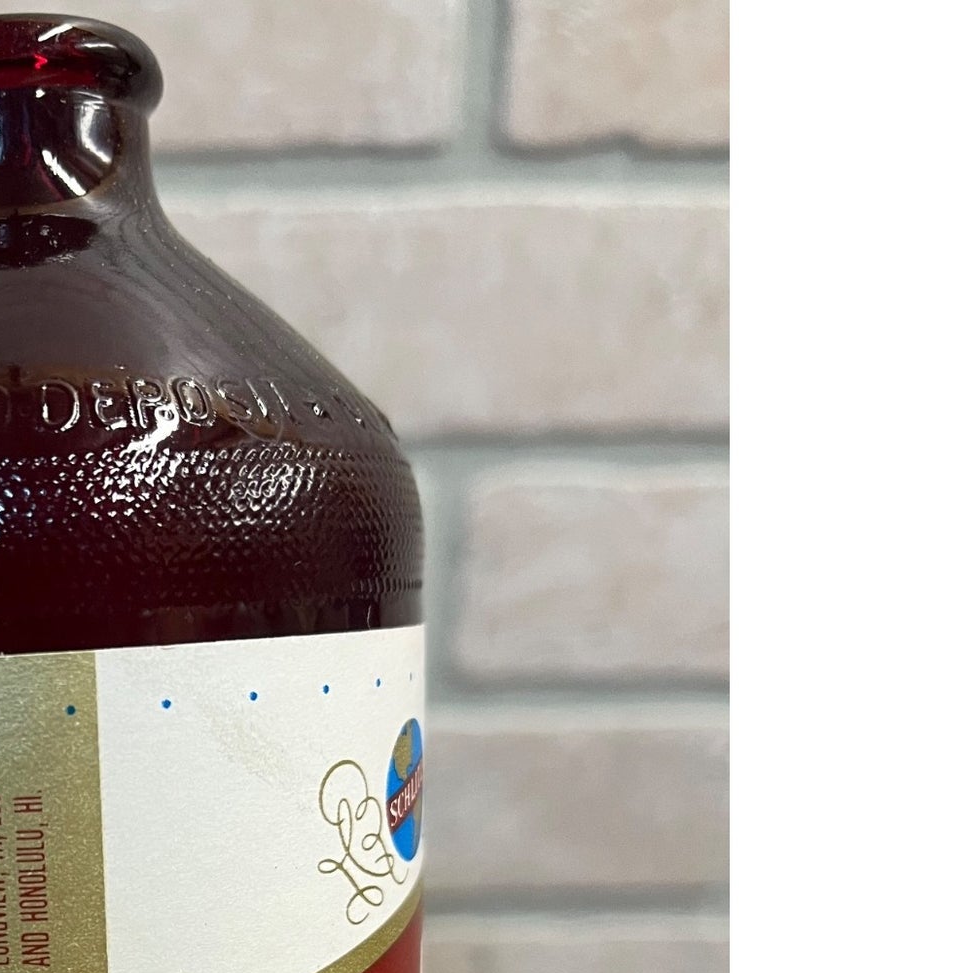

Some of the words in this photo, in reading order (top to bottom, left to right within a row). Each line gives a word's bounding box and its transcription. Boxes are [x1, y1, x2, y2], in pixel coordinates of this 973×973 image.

[40, 374, 295, 433] DEPOSIT
[13, 790, 43, 813] HI.
[15, 823, 49, 922] HONOLULU,
[21, 932, 51, 967] AND
